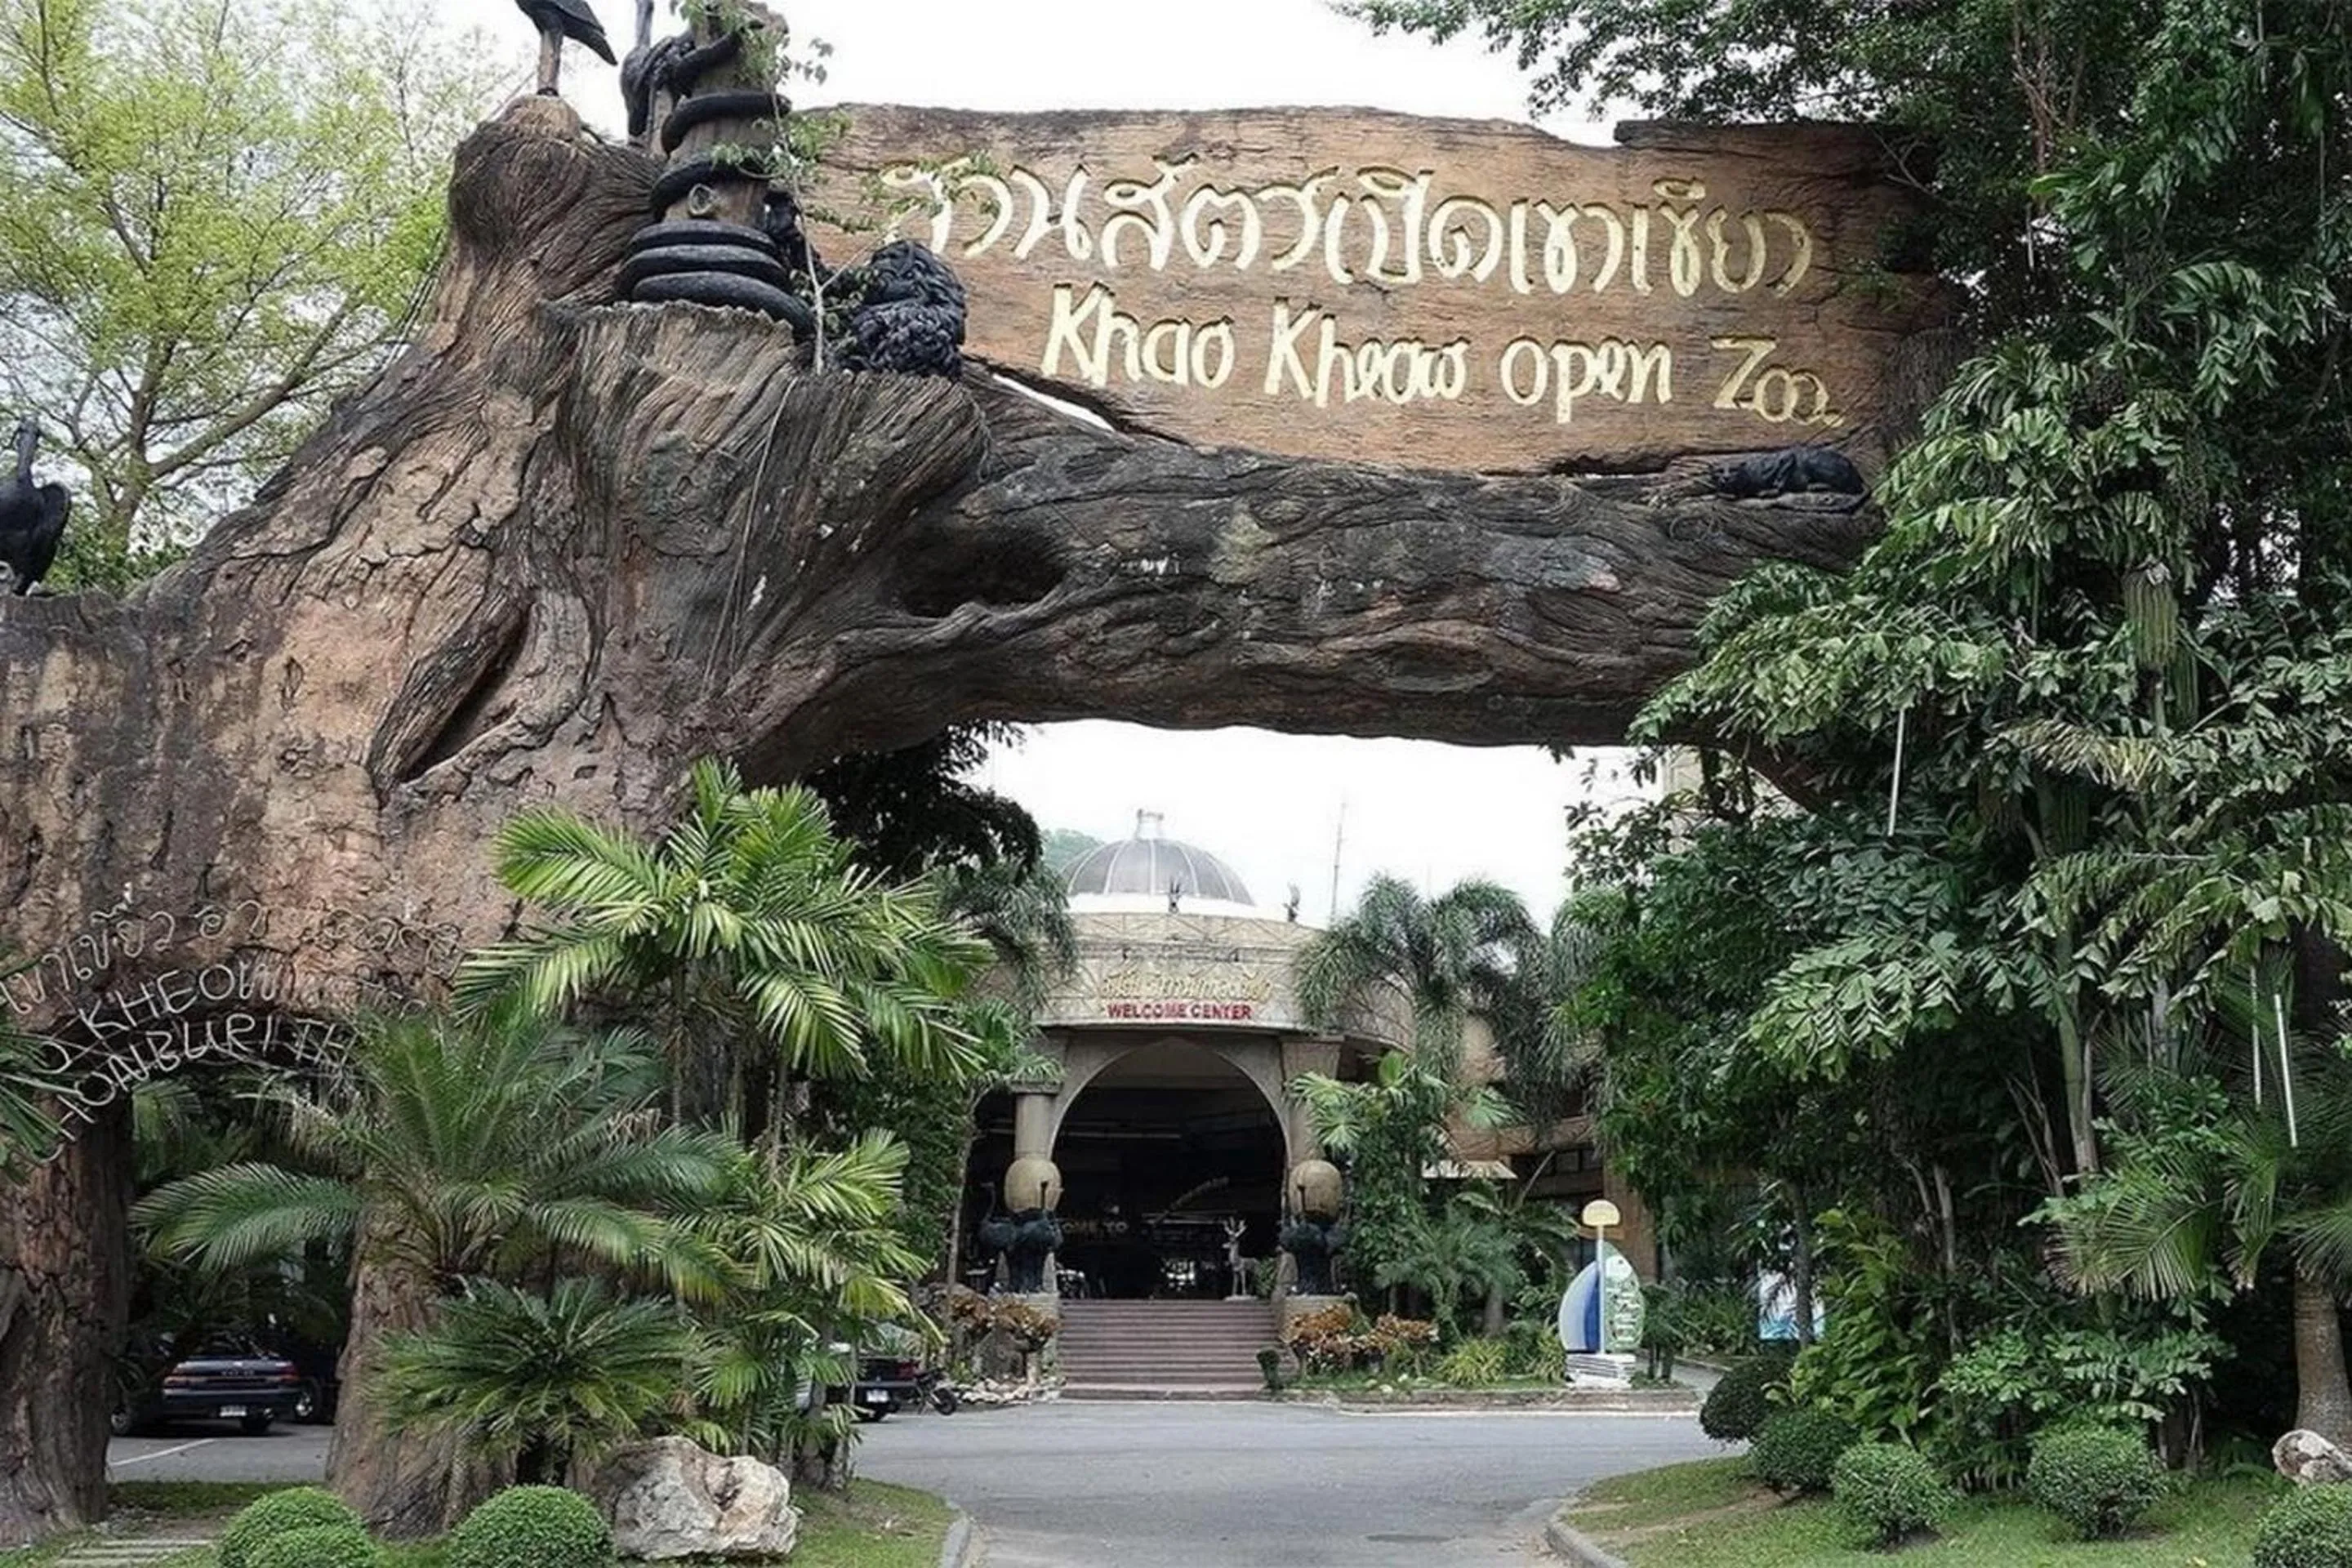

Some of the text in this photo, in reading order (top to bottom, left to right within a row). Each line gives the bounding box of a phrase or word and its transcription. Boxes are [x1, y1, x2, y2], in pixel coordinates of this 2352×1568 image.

[1040, 282, 1235, 390] Khao
[1107, 1003, 1252, 1019] WELCOME CENTER
